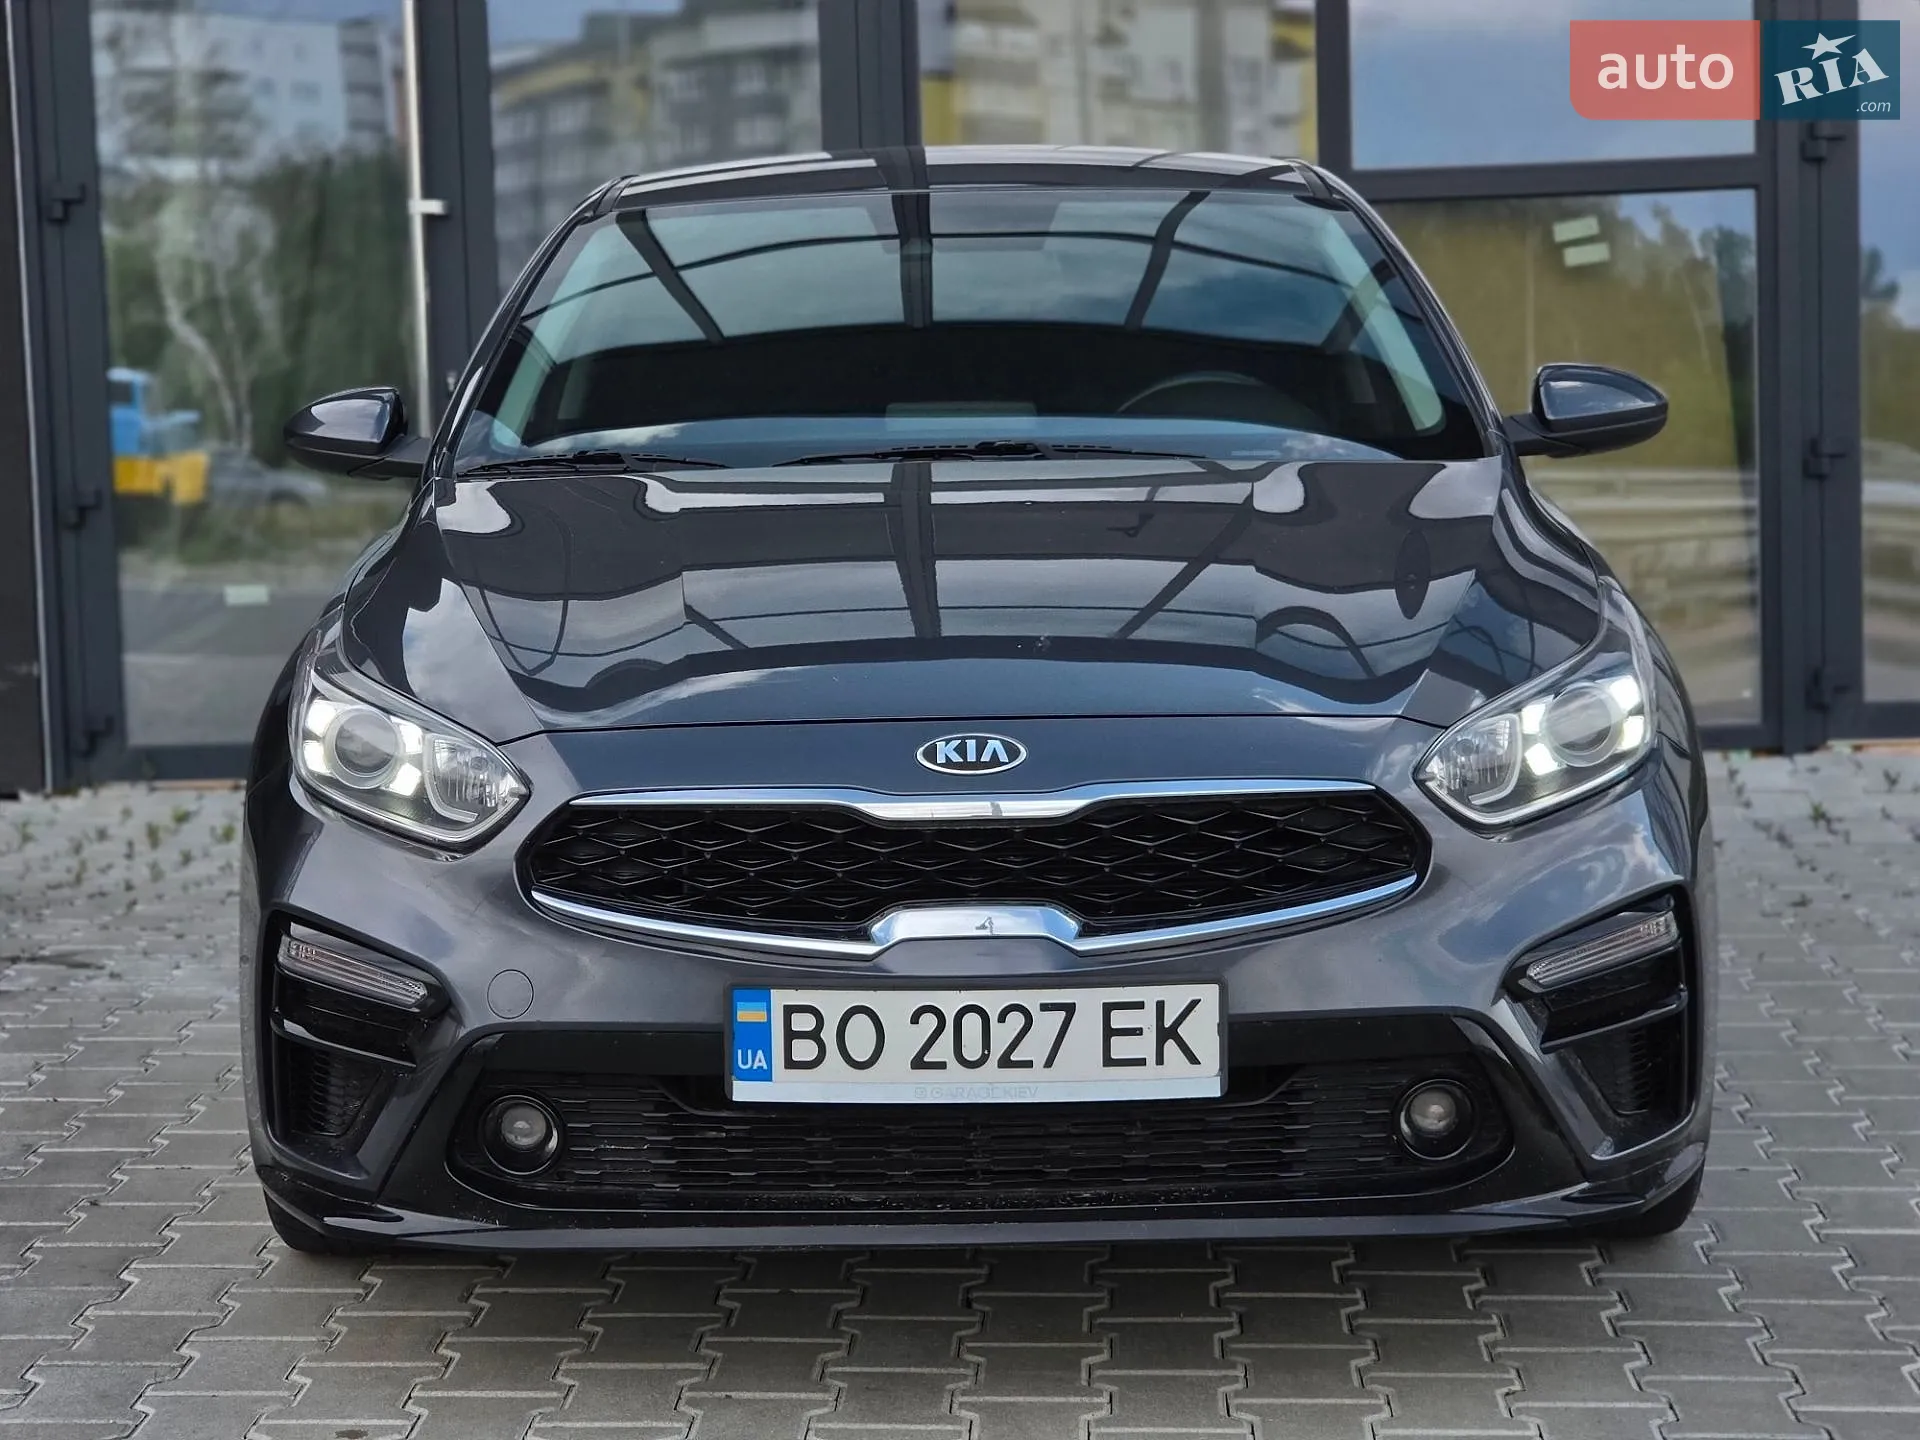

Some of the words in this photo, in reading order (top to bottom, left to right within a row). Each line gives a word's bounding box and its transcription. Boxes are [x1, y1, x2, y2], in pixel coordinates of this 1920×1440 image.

[935, 739, 1009, 764] KIA
[783, 1004, 885, 1070] BO
[910, 1002, 1076, 1070] 2027
[1102, 998, 1202, 1067] EK
[737, 1049, 768, 1070] UA
